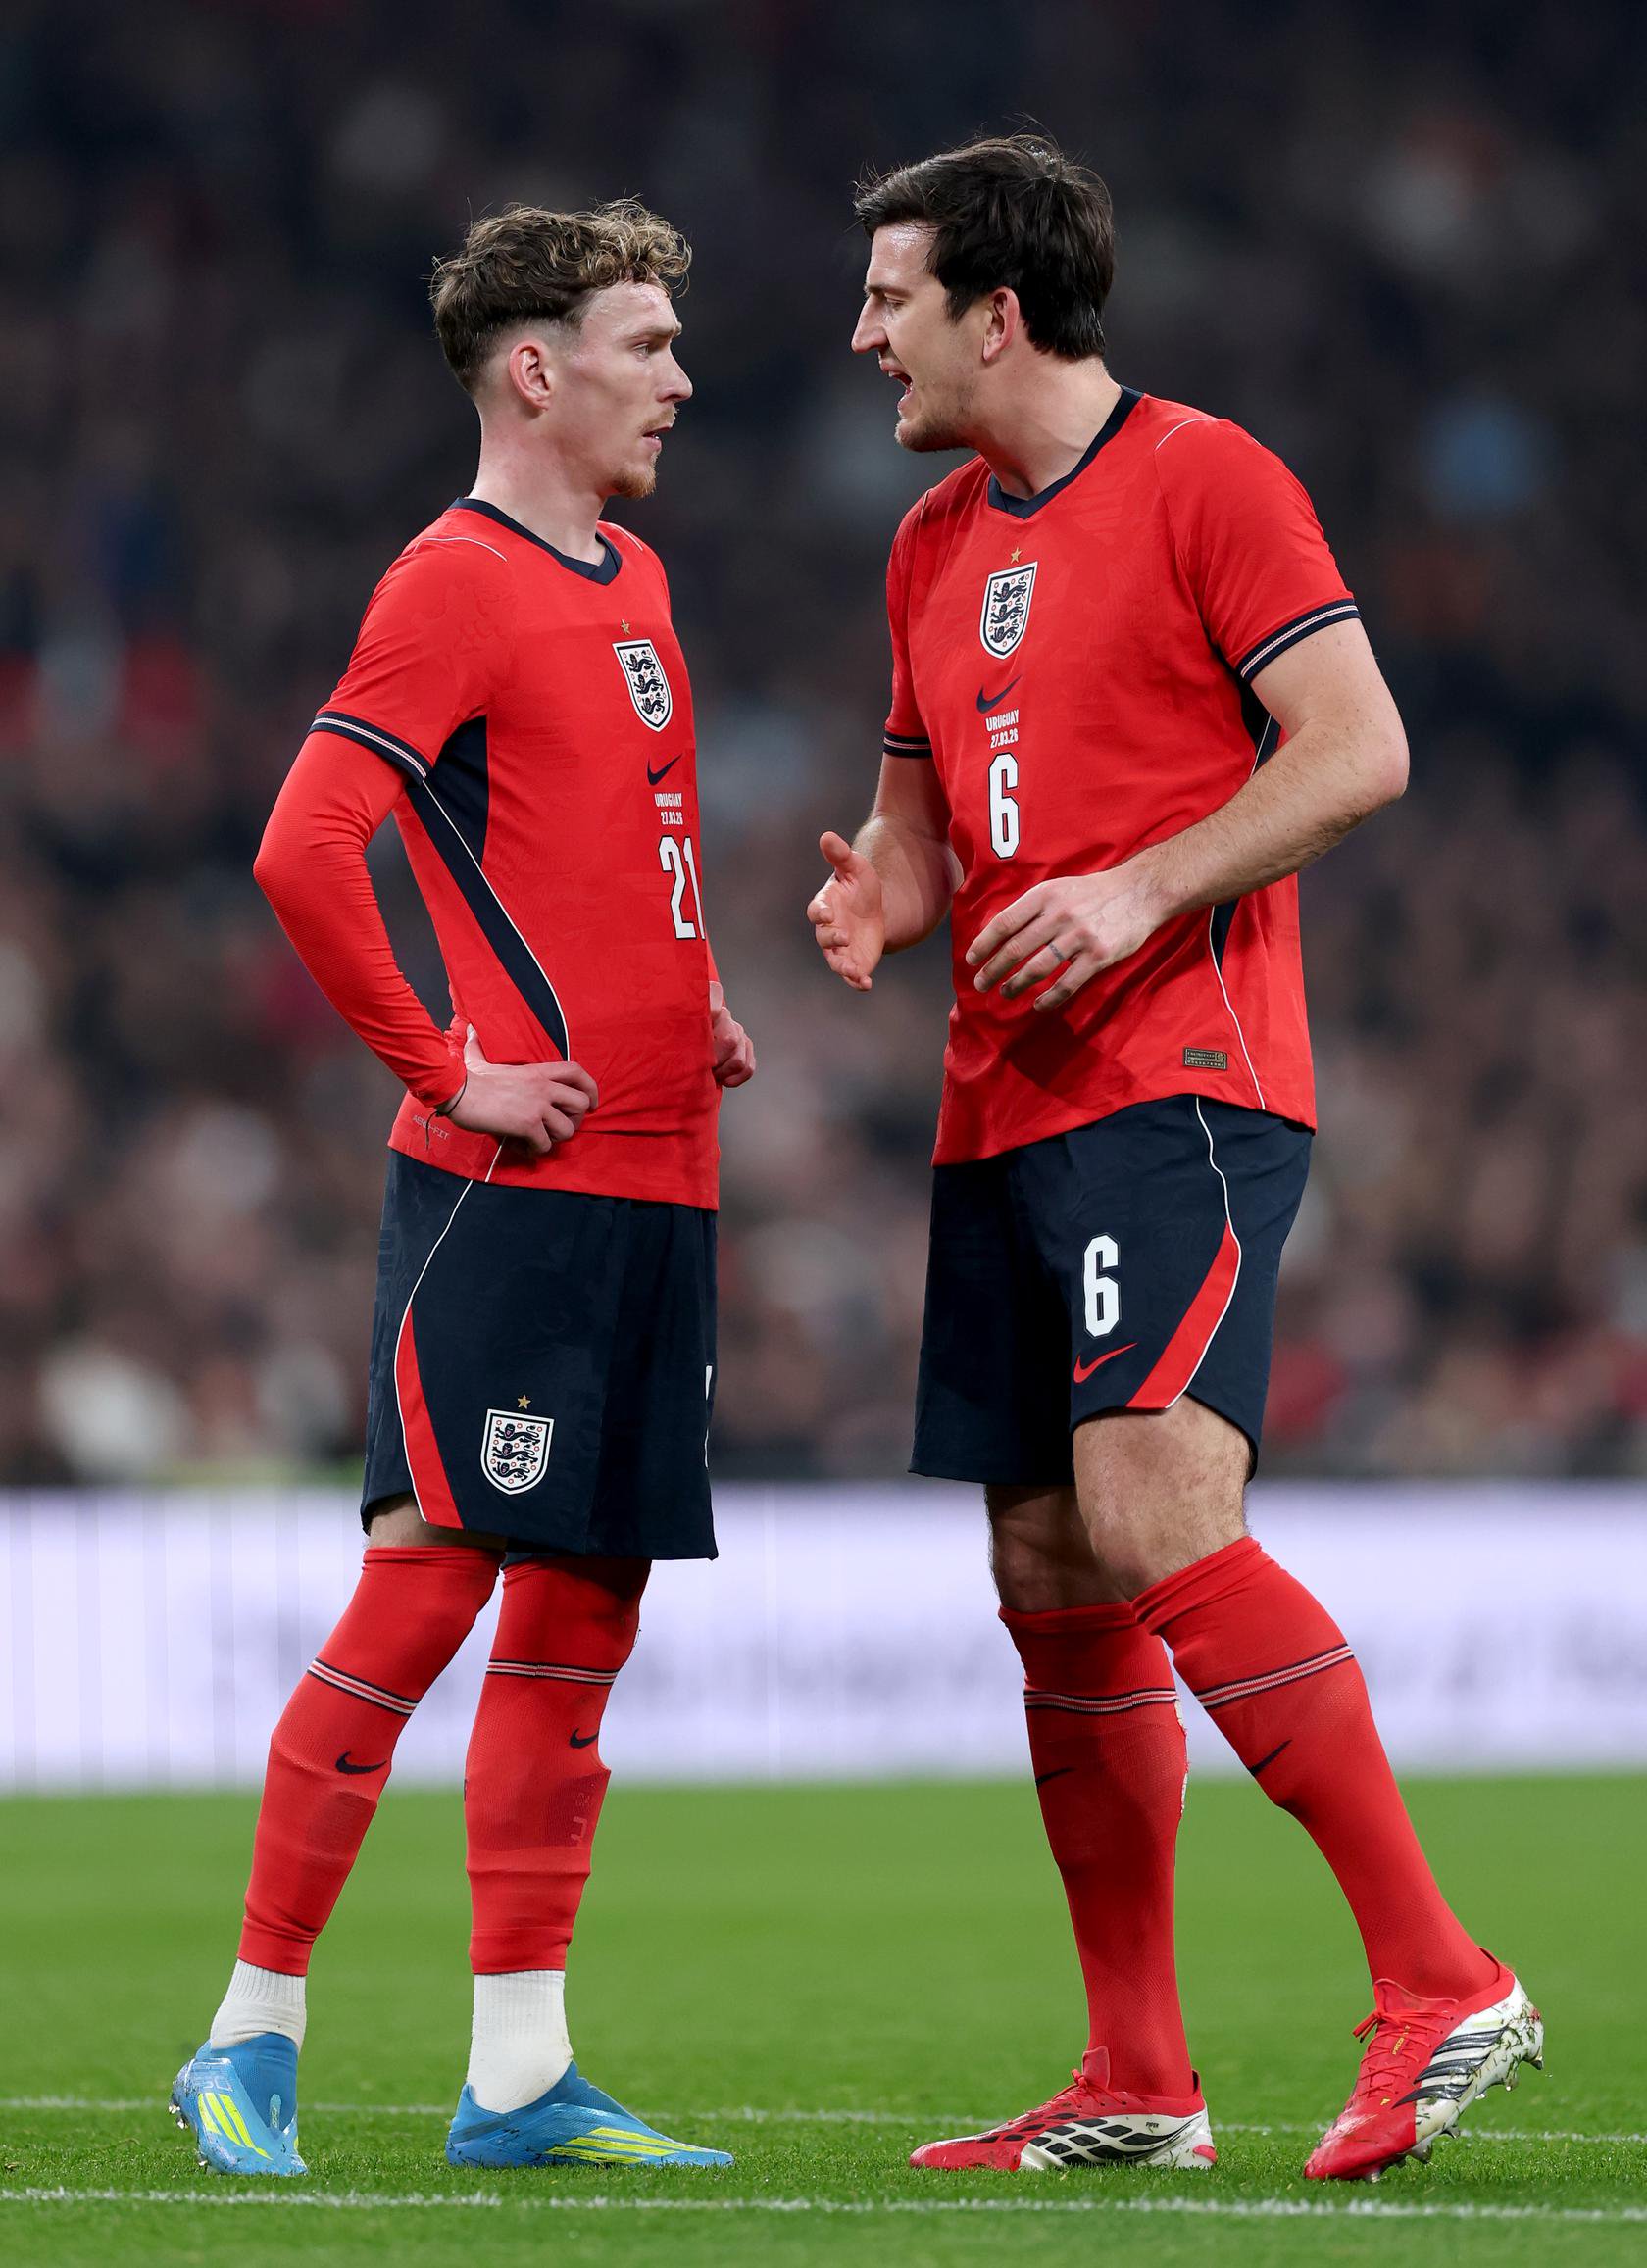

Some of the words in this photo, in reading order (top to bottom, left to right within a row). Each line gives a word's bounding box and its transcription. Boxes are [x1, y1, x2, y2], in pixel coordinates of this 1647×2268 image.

[985, 709, 1019, 732] URUGUAY
[990, 727, 1019, 749] 27.03.26
[654, 792, 682, 808] URUGUAY
[988, 752, 1020, 860] 6
[658, 835, 706, 941] 21
[1083, 1233, 1121, 1339] 6
